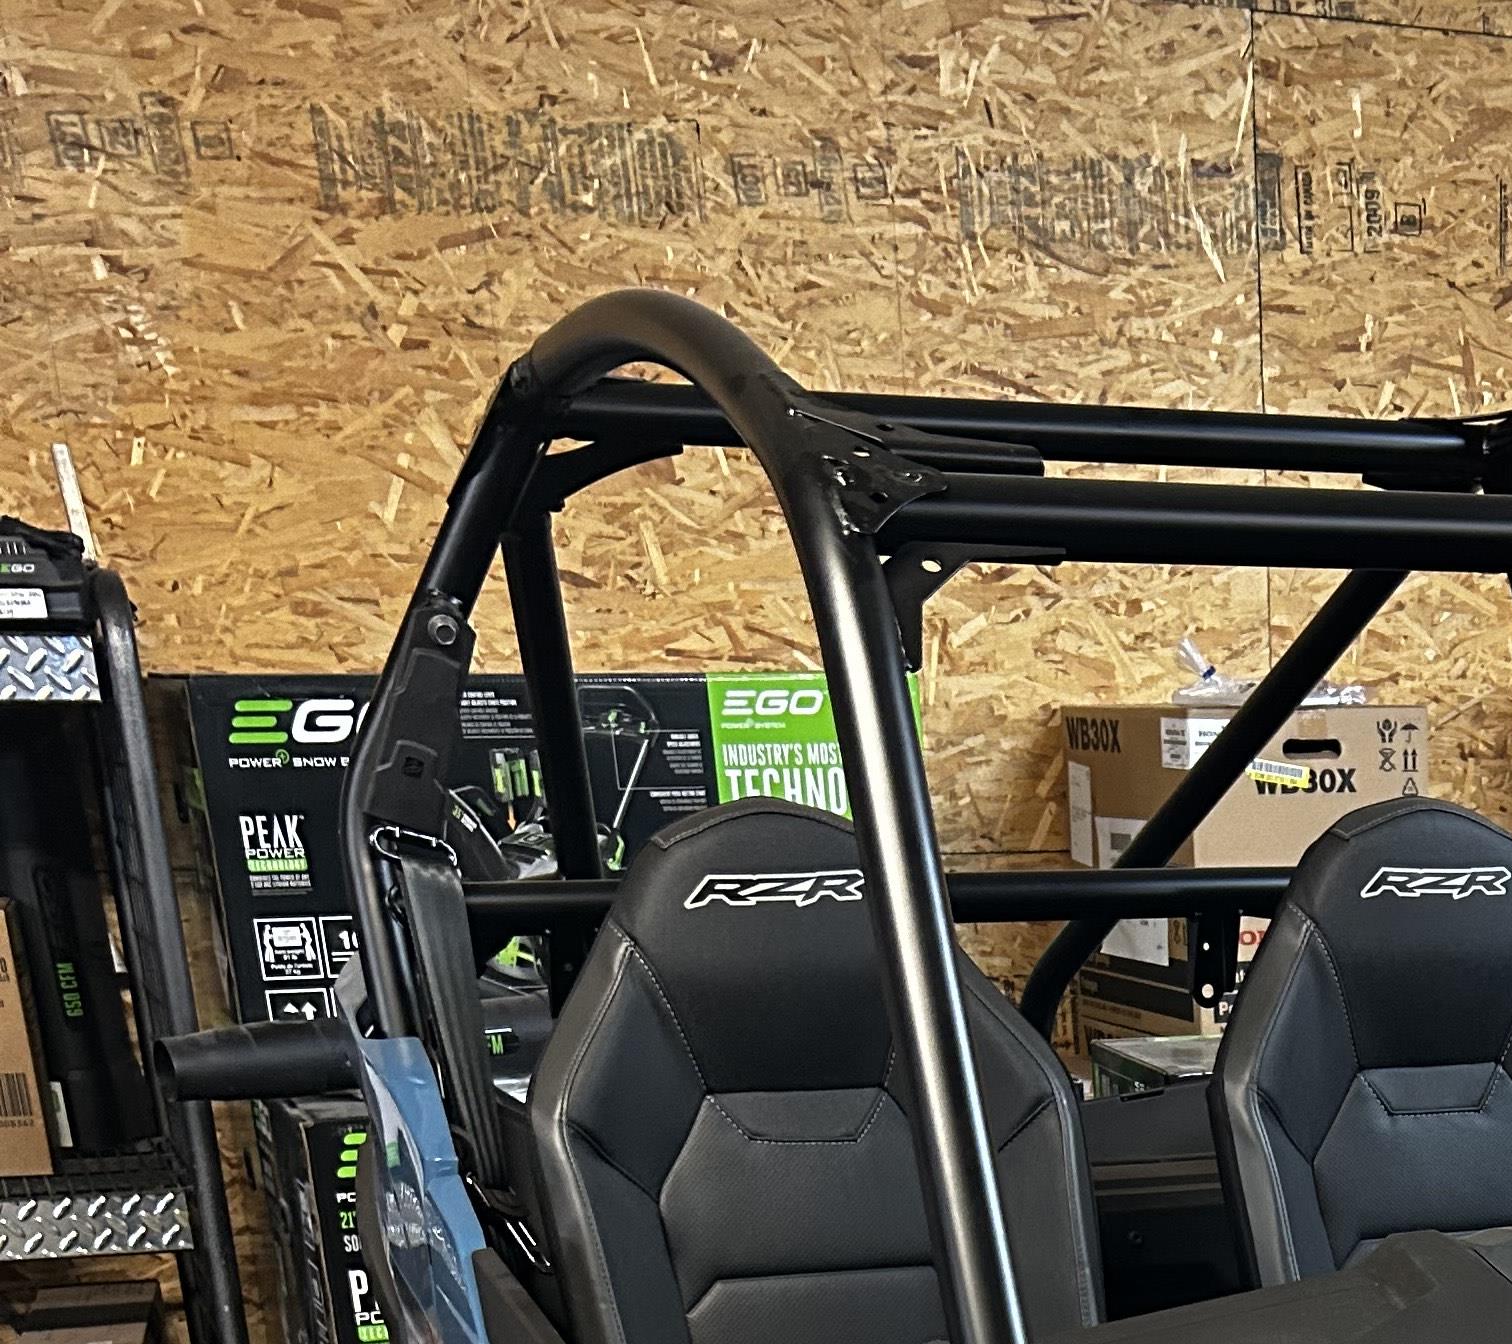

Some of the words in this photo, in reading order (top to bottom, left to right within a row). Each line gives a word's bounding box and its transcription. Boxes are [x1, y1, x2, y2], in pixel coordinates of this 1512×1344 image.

[1365, 188, 1383, 237] 2009
[0, 563, 35, 573] EGO
[721, 689, 824, 716] EGO
[229, 699, 370, 744] EG
[1065, 716, 1121, 754] WB30X
[228, 757, 282, 769] POWER
[293, 756, 336, 768] SNOW
[722, 743, 803, 767] INDUSTRY'S
[239, 815, 304, 849] PEAK
[245, 848, 306, 860] POWER
[684, 868, 865, 910] RZR
[1360, 866, 1512, 900] RZR
[56, 962, 79, 990] CFM
[62, 992, 84, 1017] 650
